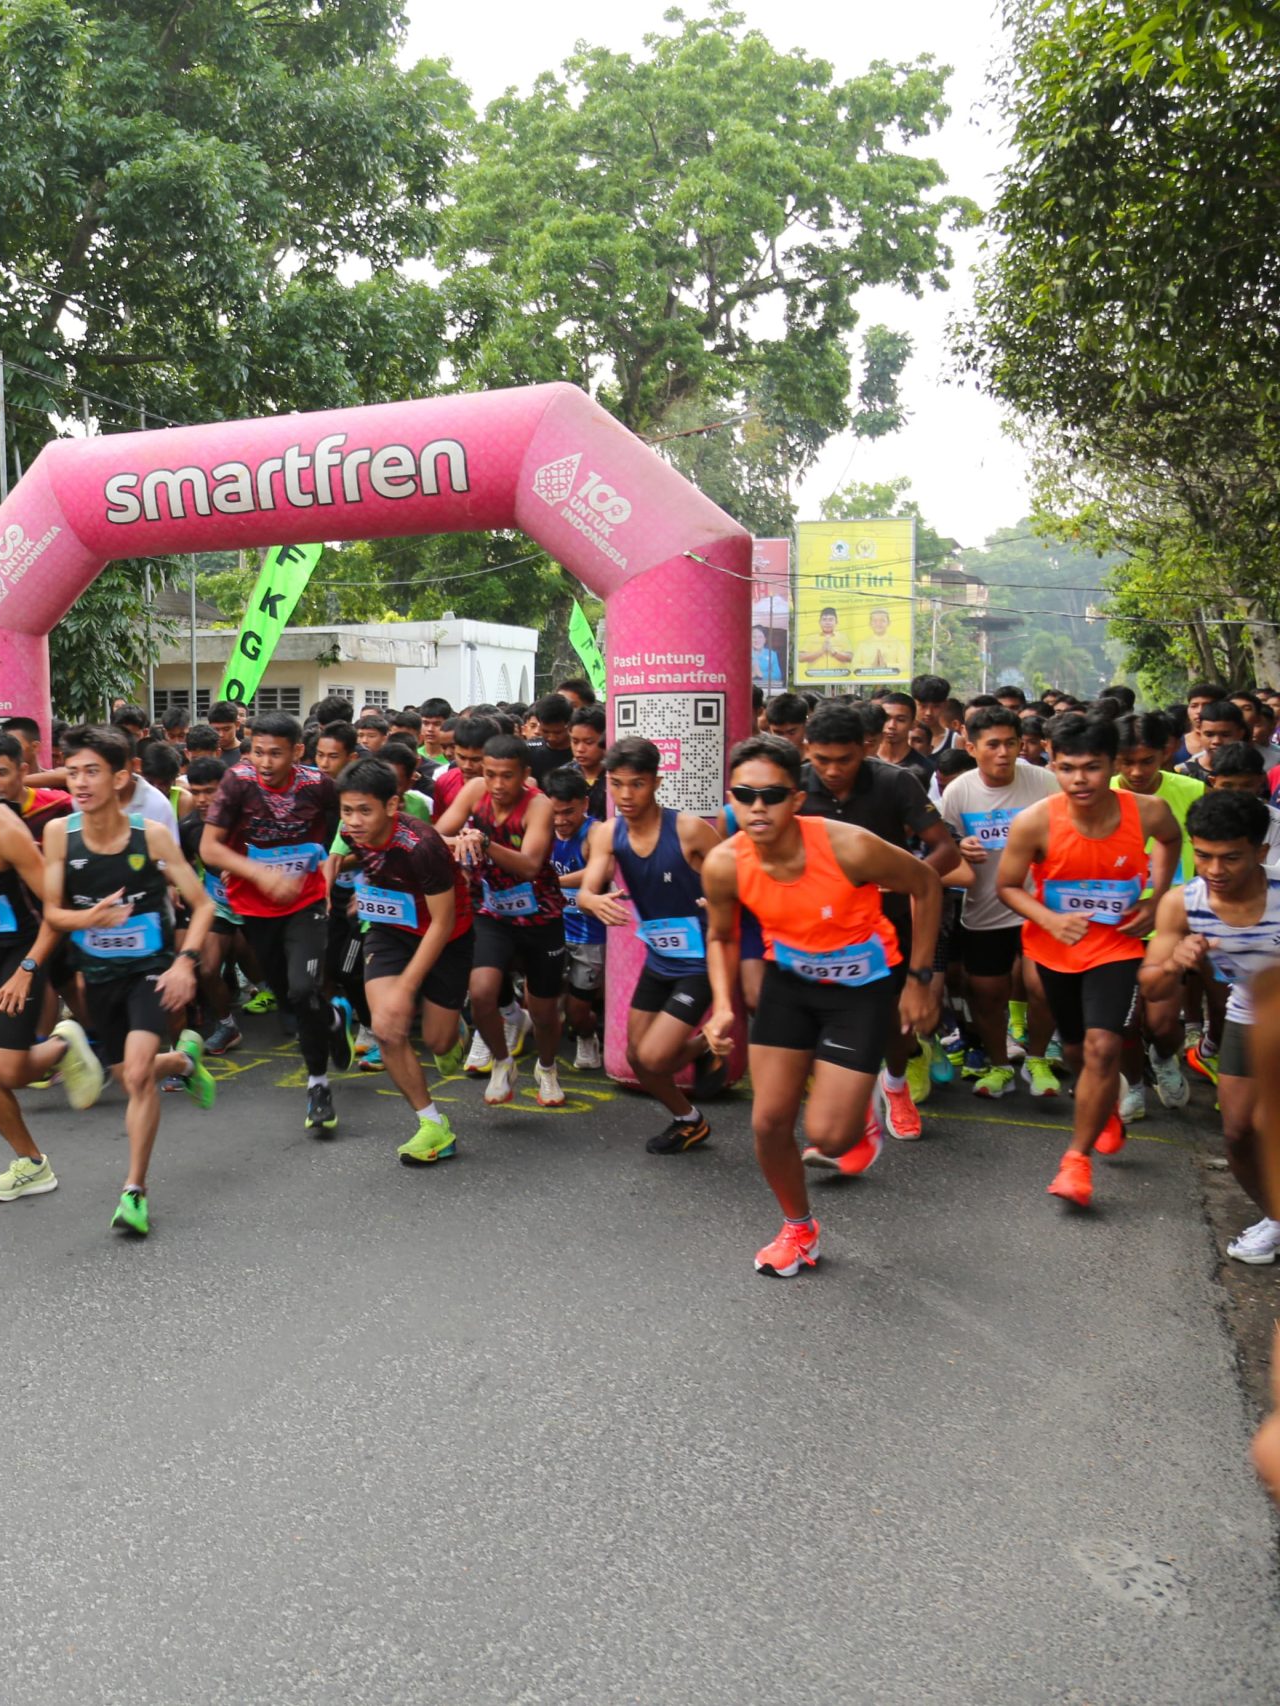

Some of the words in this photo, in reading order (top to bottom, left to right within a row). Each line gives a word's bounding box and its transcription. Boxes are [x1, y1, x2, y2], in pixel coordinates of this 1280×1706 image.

[104, 433, 469, 524] smartfren
[569, 496, 614, 537] UNTUK
[560, 507, 628, 570] INDONESIA
[0, 538, 35, 576] UNTUK
[8, 526, 62, 584] INDONESIA
[814, 573, 850, 588] Idul
[856, 571, 893, 587] Fitri
[613, 653, 641, 668] Pasti
[644, 653, 705, 667] Untung
[613, 672, 645, 686] Pakai
[648, 670, 727, 684] smartfren
[656, 742, 677, 750] CAN
[980, 826, 1009, 840] 049
[357, 900, 397, 916] 0882
[1069, 898, 1122, 913] 0649
[800, 964, 862, 978] 0972
